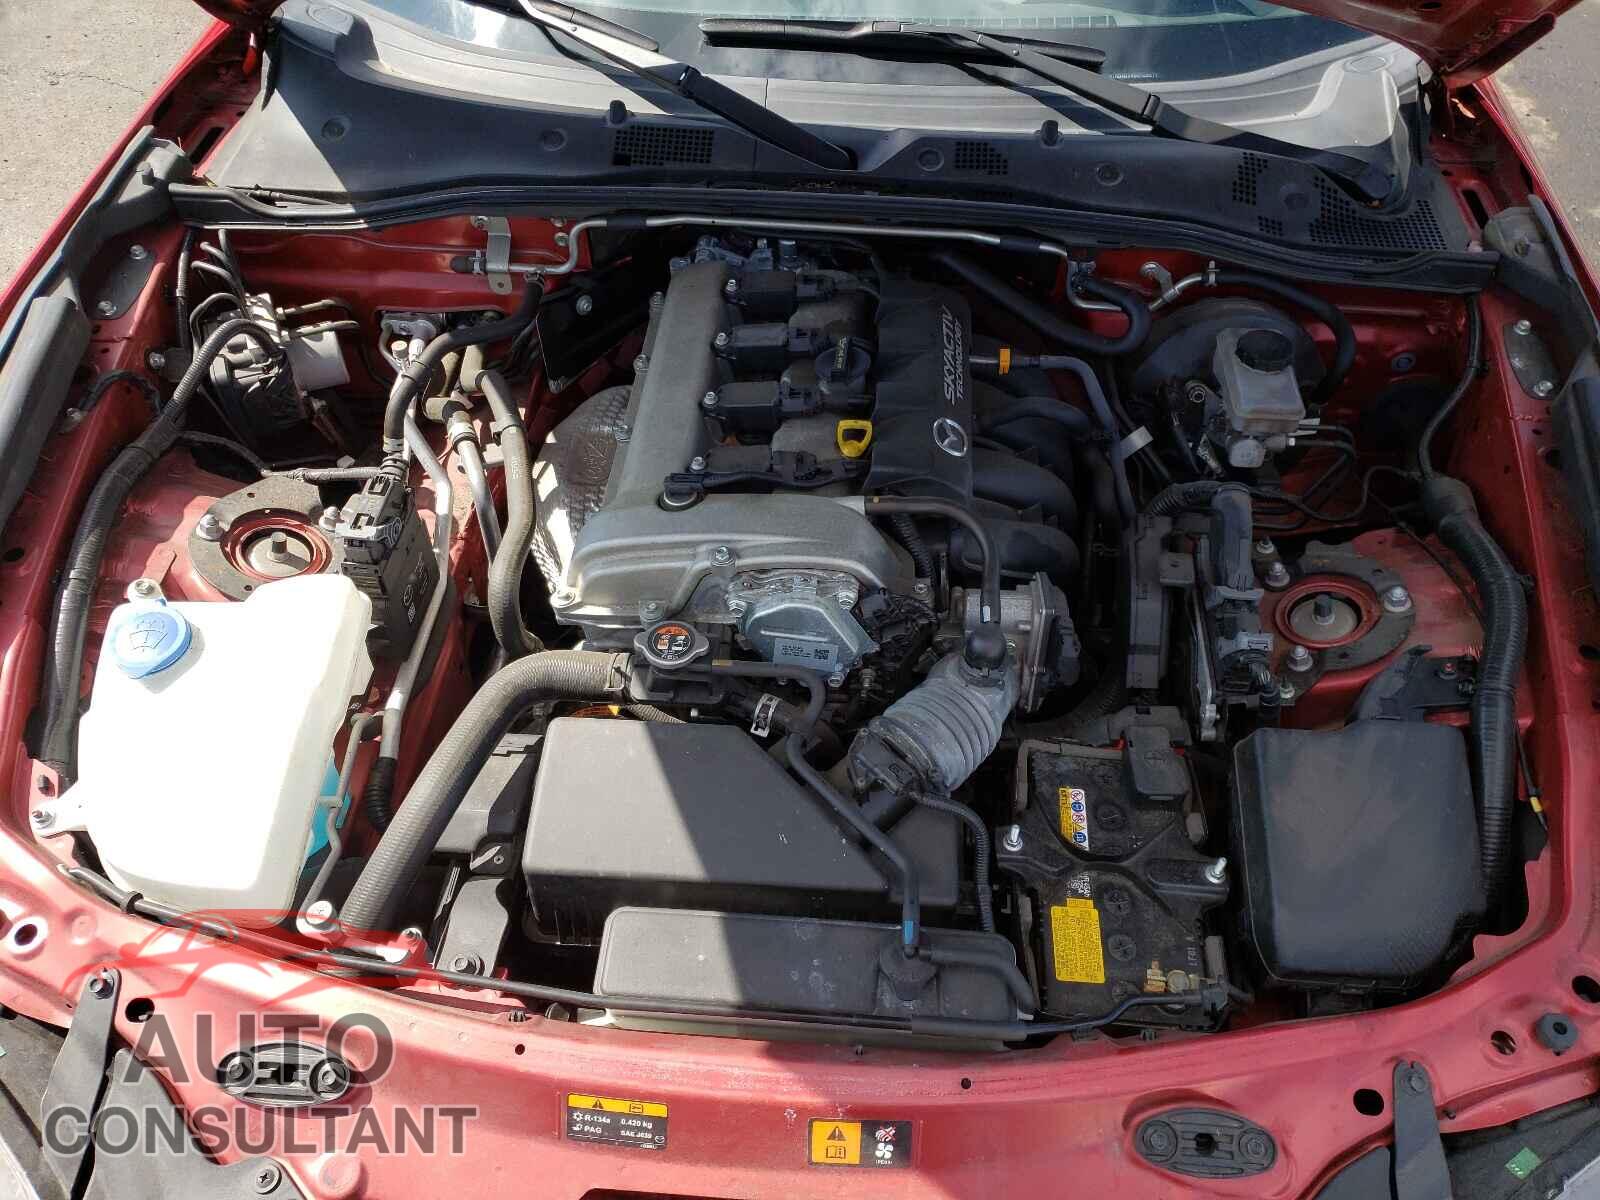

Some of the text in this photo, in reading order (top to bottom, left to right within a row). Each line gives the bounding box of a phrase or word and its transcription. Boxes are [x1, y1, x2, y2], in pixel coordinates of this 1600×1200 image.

[943, 304, 955, 406] SKYACTIV
[955, 319, 964, 400] TECHNOLOGY
[584, 1114, 611, 1124] R-134a
[620, 1118, 641, 1127] 0.420
[584, 1125, 602, 1134] PAG
